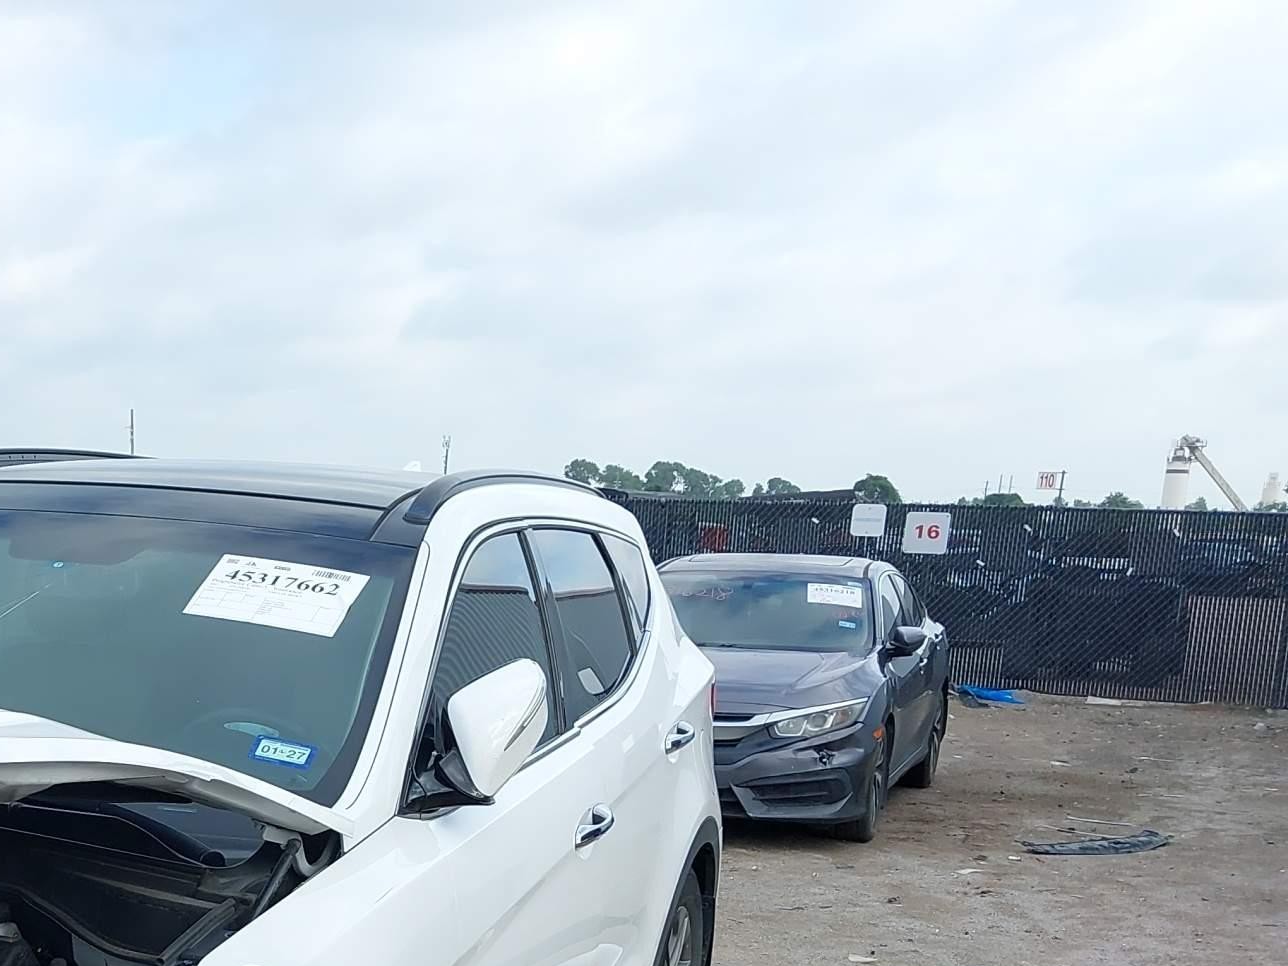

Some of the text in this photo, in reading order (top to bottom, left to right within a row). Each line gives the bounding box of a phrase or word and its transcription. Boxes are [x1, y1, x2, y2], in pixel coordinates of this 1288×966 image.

[1039, 474, 1055, 488] 110
[914, 524, 941, 541] 16
[225, 569, 341, 596] 45317662
